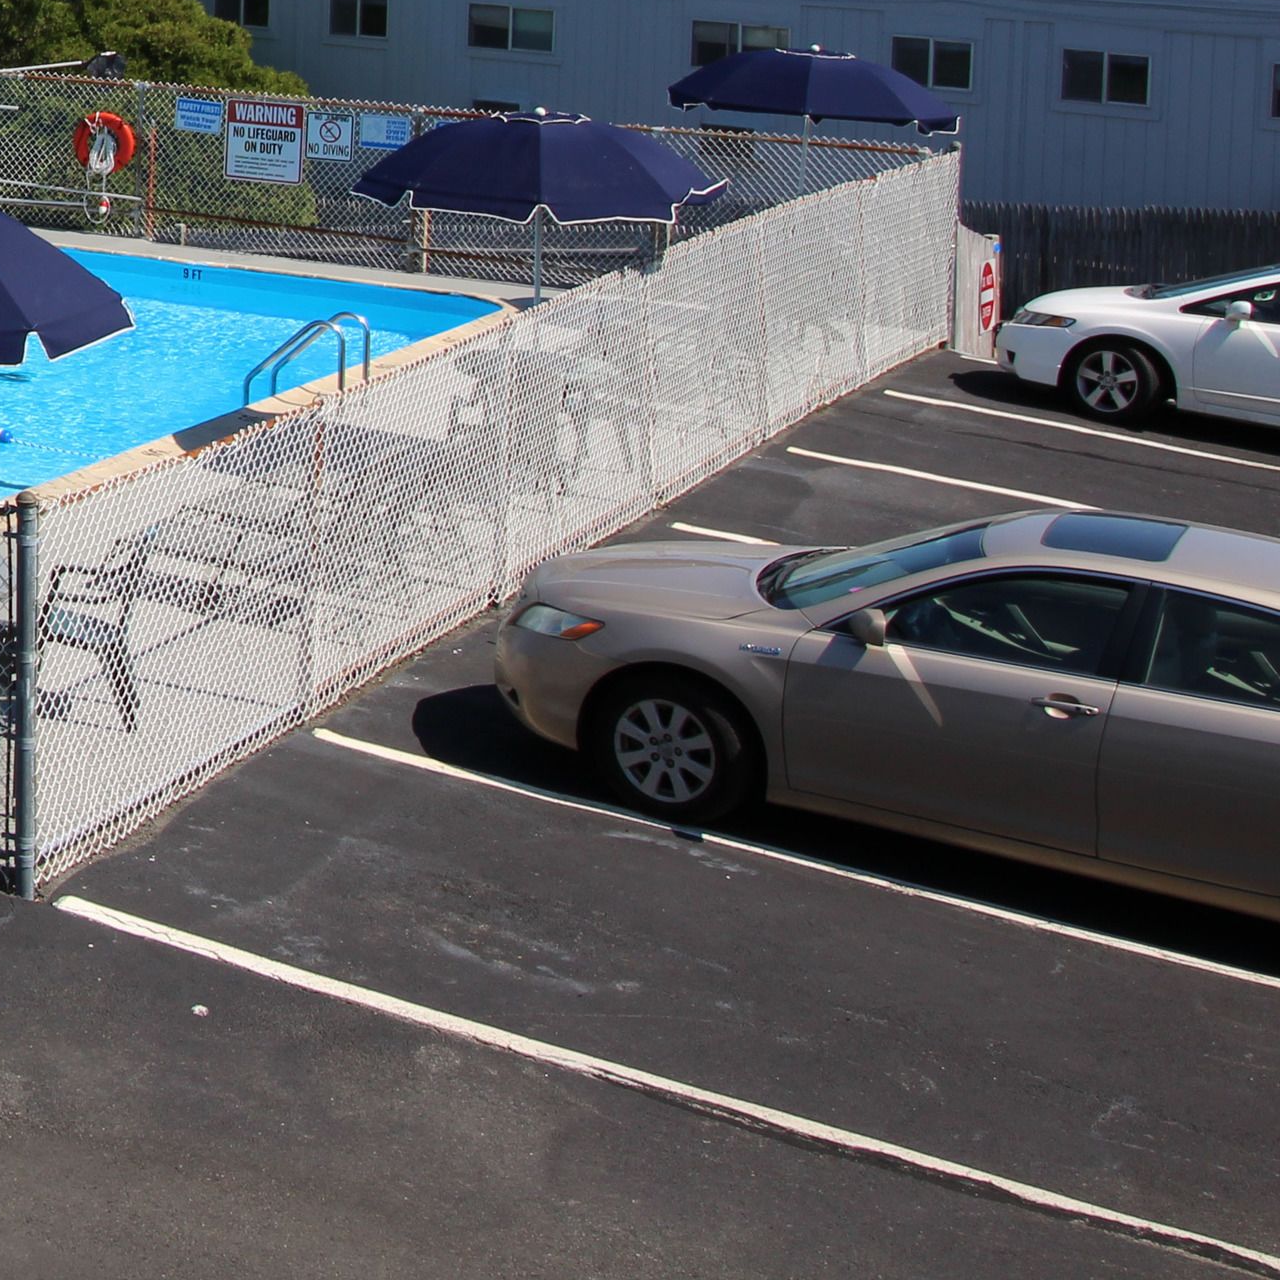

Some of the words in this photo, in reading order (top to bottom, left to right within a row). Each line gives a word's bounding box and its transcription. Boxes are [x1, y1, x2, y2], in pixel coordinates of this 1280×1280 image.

[235, 103, 297, 126] WARNING
[233, 126, 245, 138] NO
[247, 127, 296, 143] LIFEGUARD
[244, 141, 257, 153] ON
[259, 143, 284, 156] DUTY
[308, 142, 320, 155] NO
[322, 143, 350, 157] DIVING
[191, 269, 203, 281] FT
